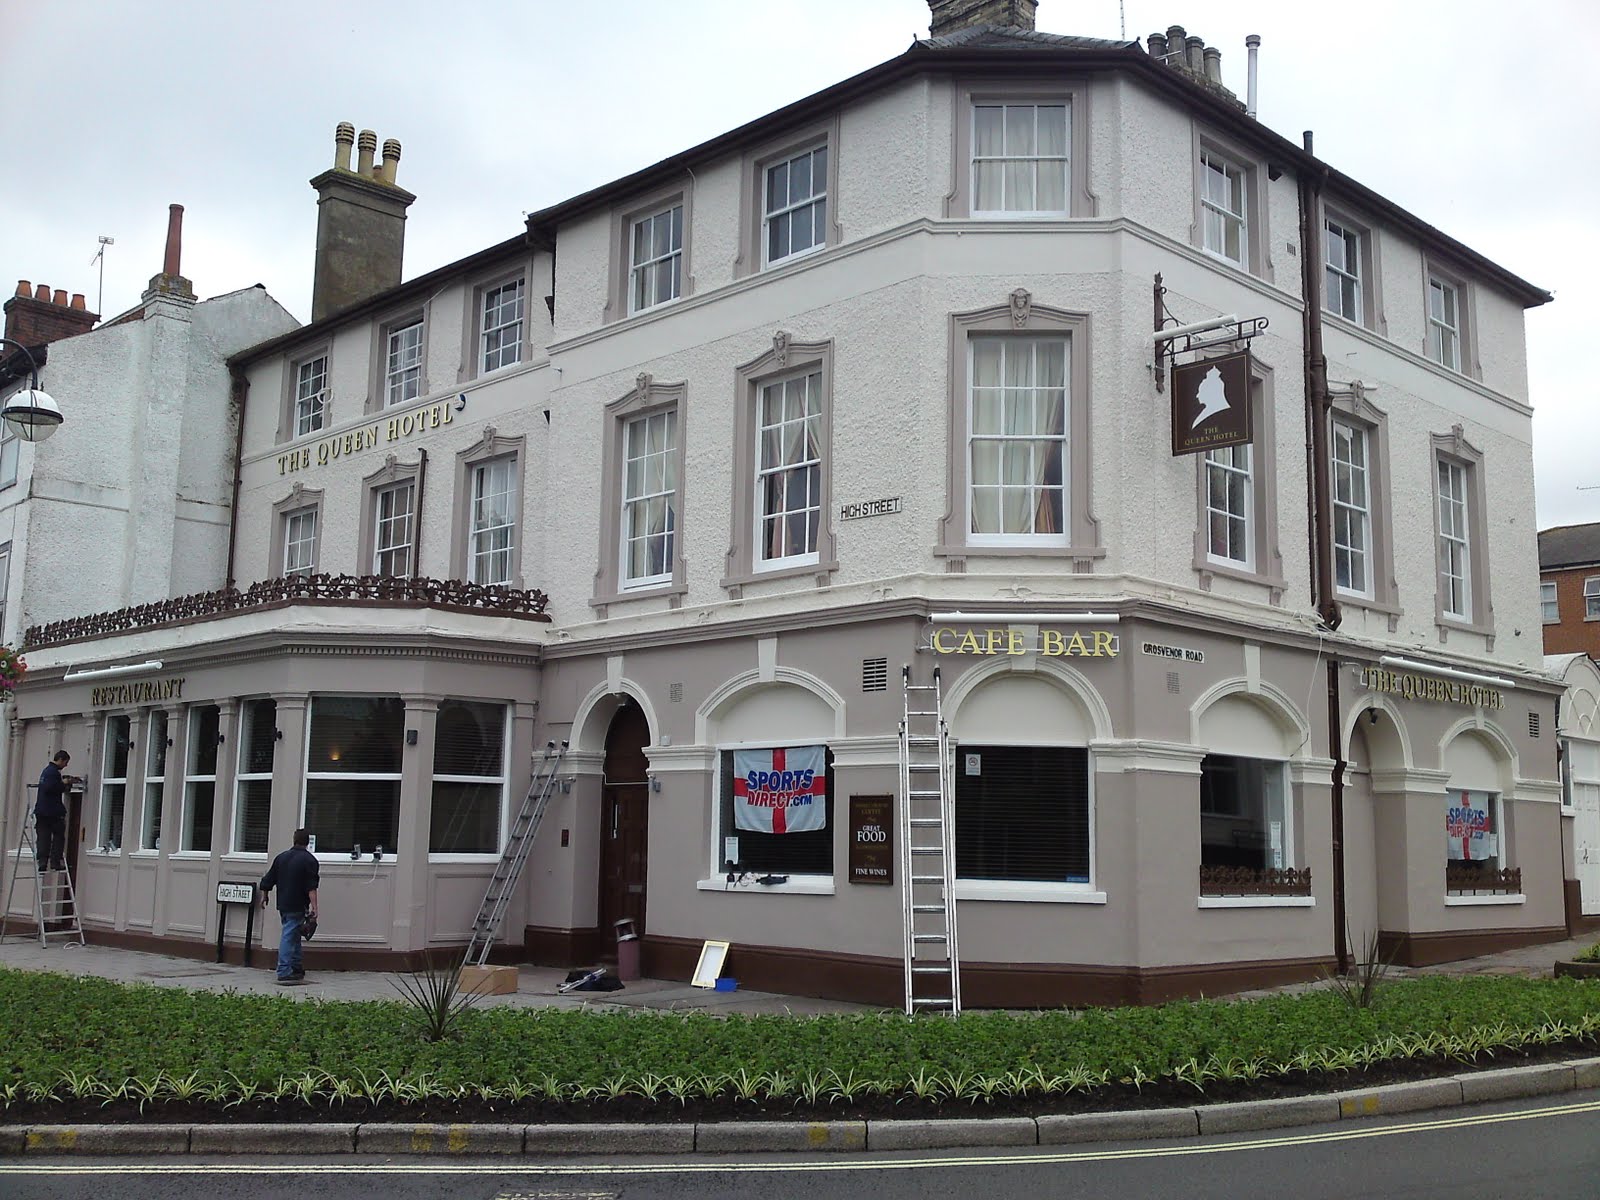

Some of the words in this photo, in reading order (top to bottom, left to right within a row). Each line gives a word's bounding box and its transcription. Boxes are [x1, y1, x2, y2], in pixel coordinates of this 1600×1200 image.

[278, 447, 310, 475] THE
[317, 425, 379, 467] QUEEN
[386, 402, 454, 442] HOTEL
[1184, 434, 1211, 446] QUEEN
[1212, 431, 1238, 441] HOTEL
[1204, 427, 1218, 435] THE
[840, 503, 861, 519] HIGH
[862, 497, 900, 516] STREET
[933, 627, 1026, 656] CAFE
[1040, 630, 1118, 657] BAR
[1143, 643, 1183, 659] GROSVENOR
[1185, 650, 1203, 662] ROAD
[91, 678, 185, 706] RESTAURANT
[1363, 667, 1397, 693] THE
[1400, 673, 1454, 702] QUEEN
[1458, 683, 1506, 711] HOTEL
[746, 769, 815, 791] SPORTS
[857, 831, 886, 842] FOOD
[855, 867, 868, 876] FINE
[868, 868, 887, 876] WINES
[219, 888, 231, 898] HIGH
[232, 889, 251, 899] STREET
